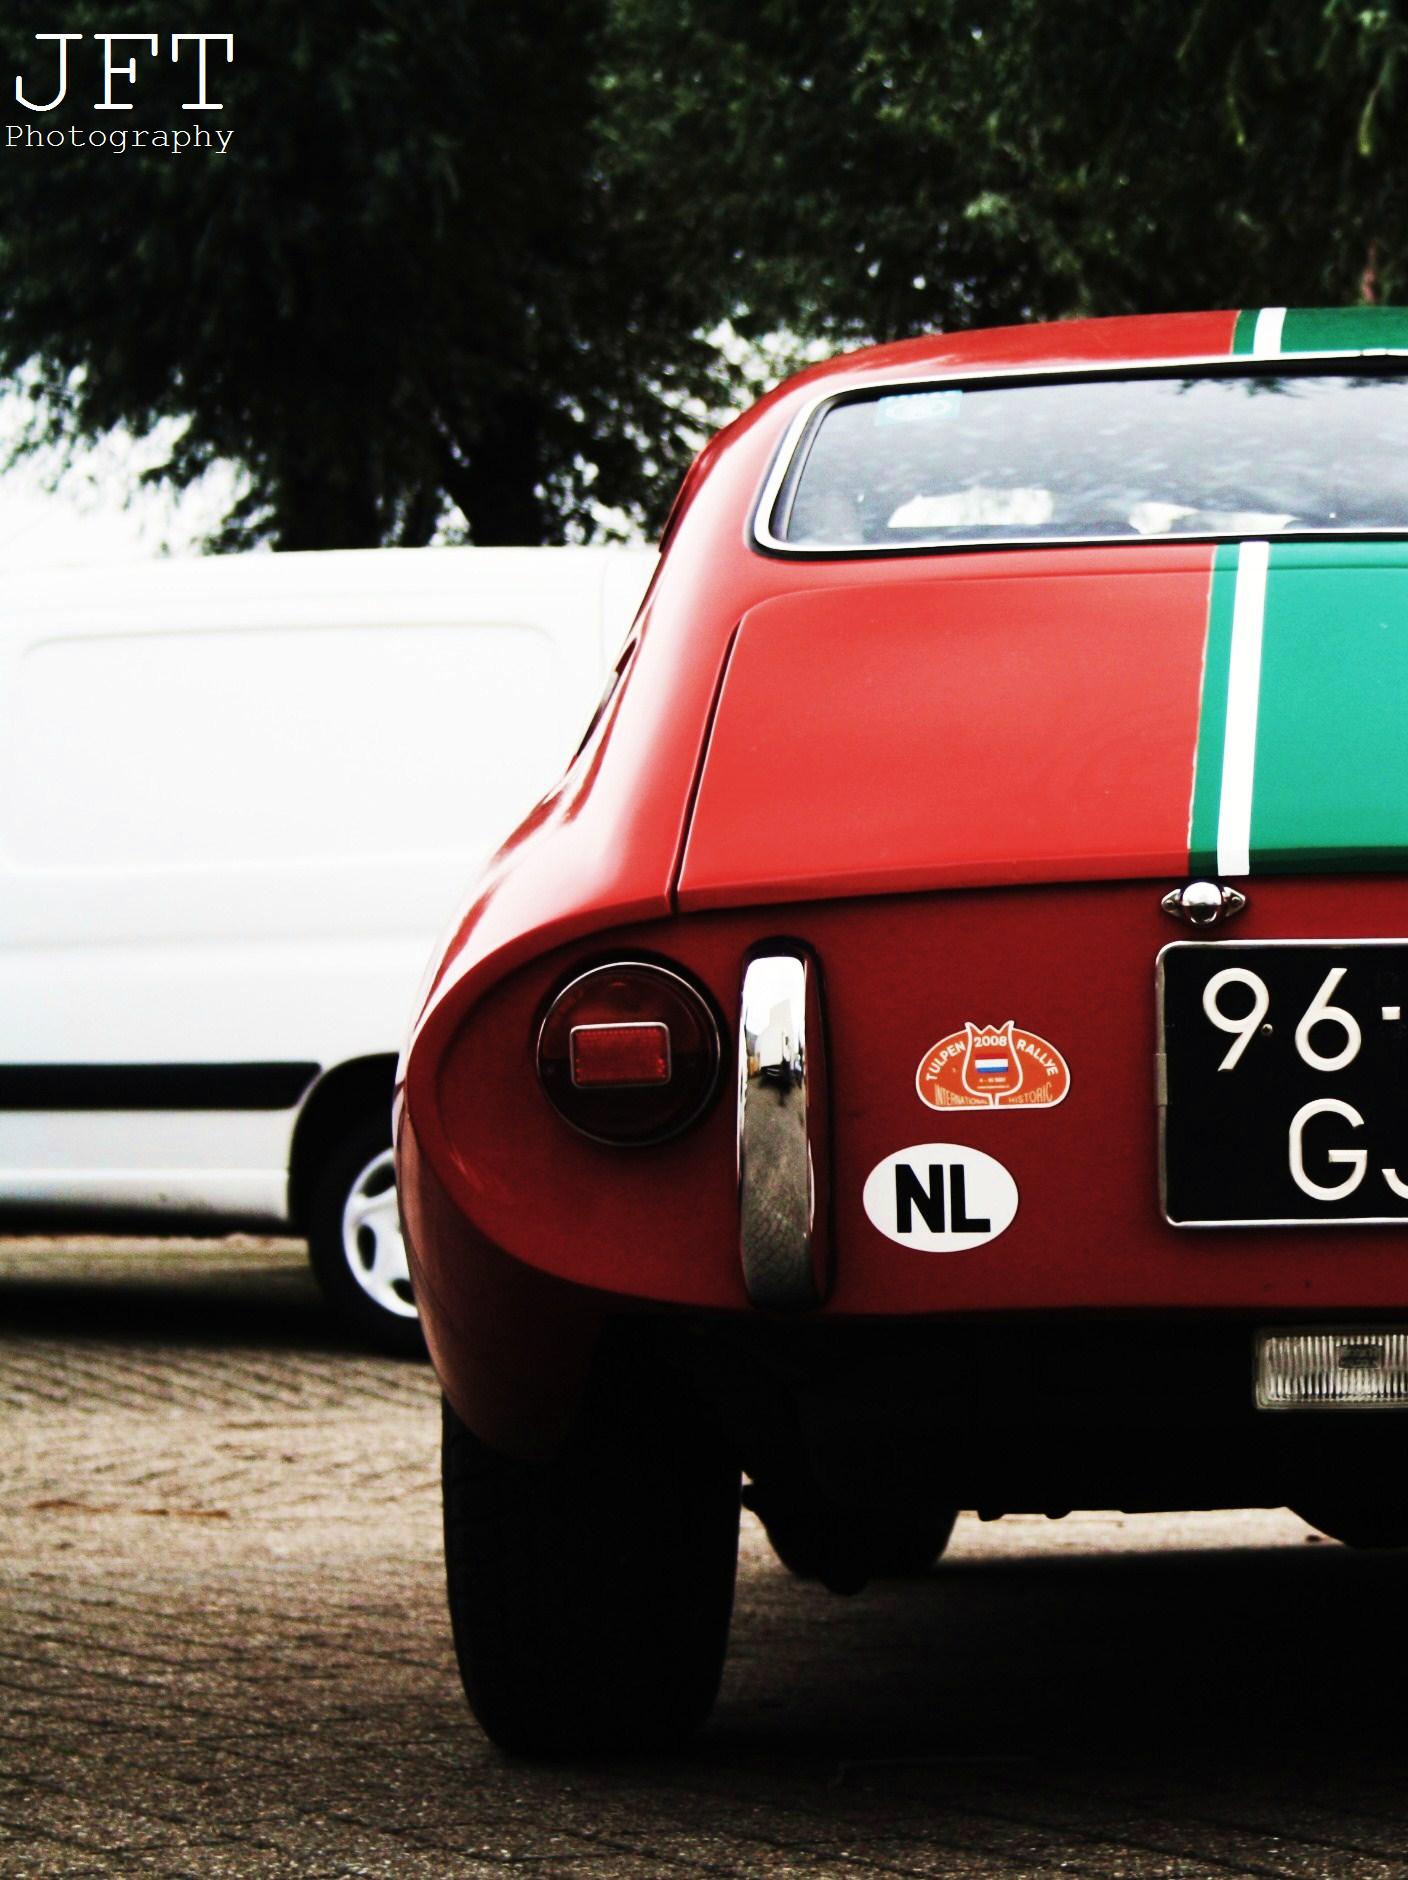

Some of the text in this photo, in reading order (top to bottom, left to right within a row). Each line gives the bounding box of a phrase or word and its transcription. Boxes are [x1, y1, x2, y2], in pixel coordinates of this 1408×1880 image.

[926, 1035, 1060, 1082] TULPEN 2008 RALLYE
[1008, 1081, 1053, 1104] HISTORIC
[895, 1164, 991, 1233] NL
